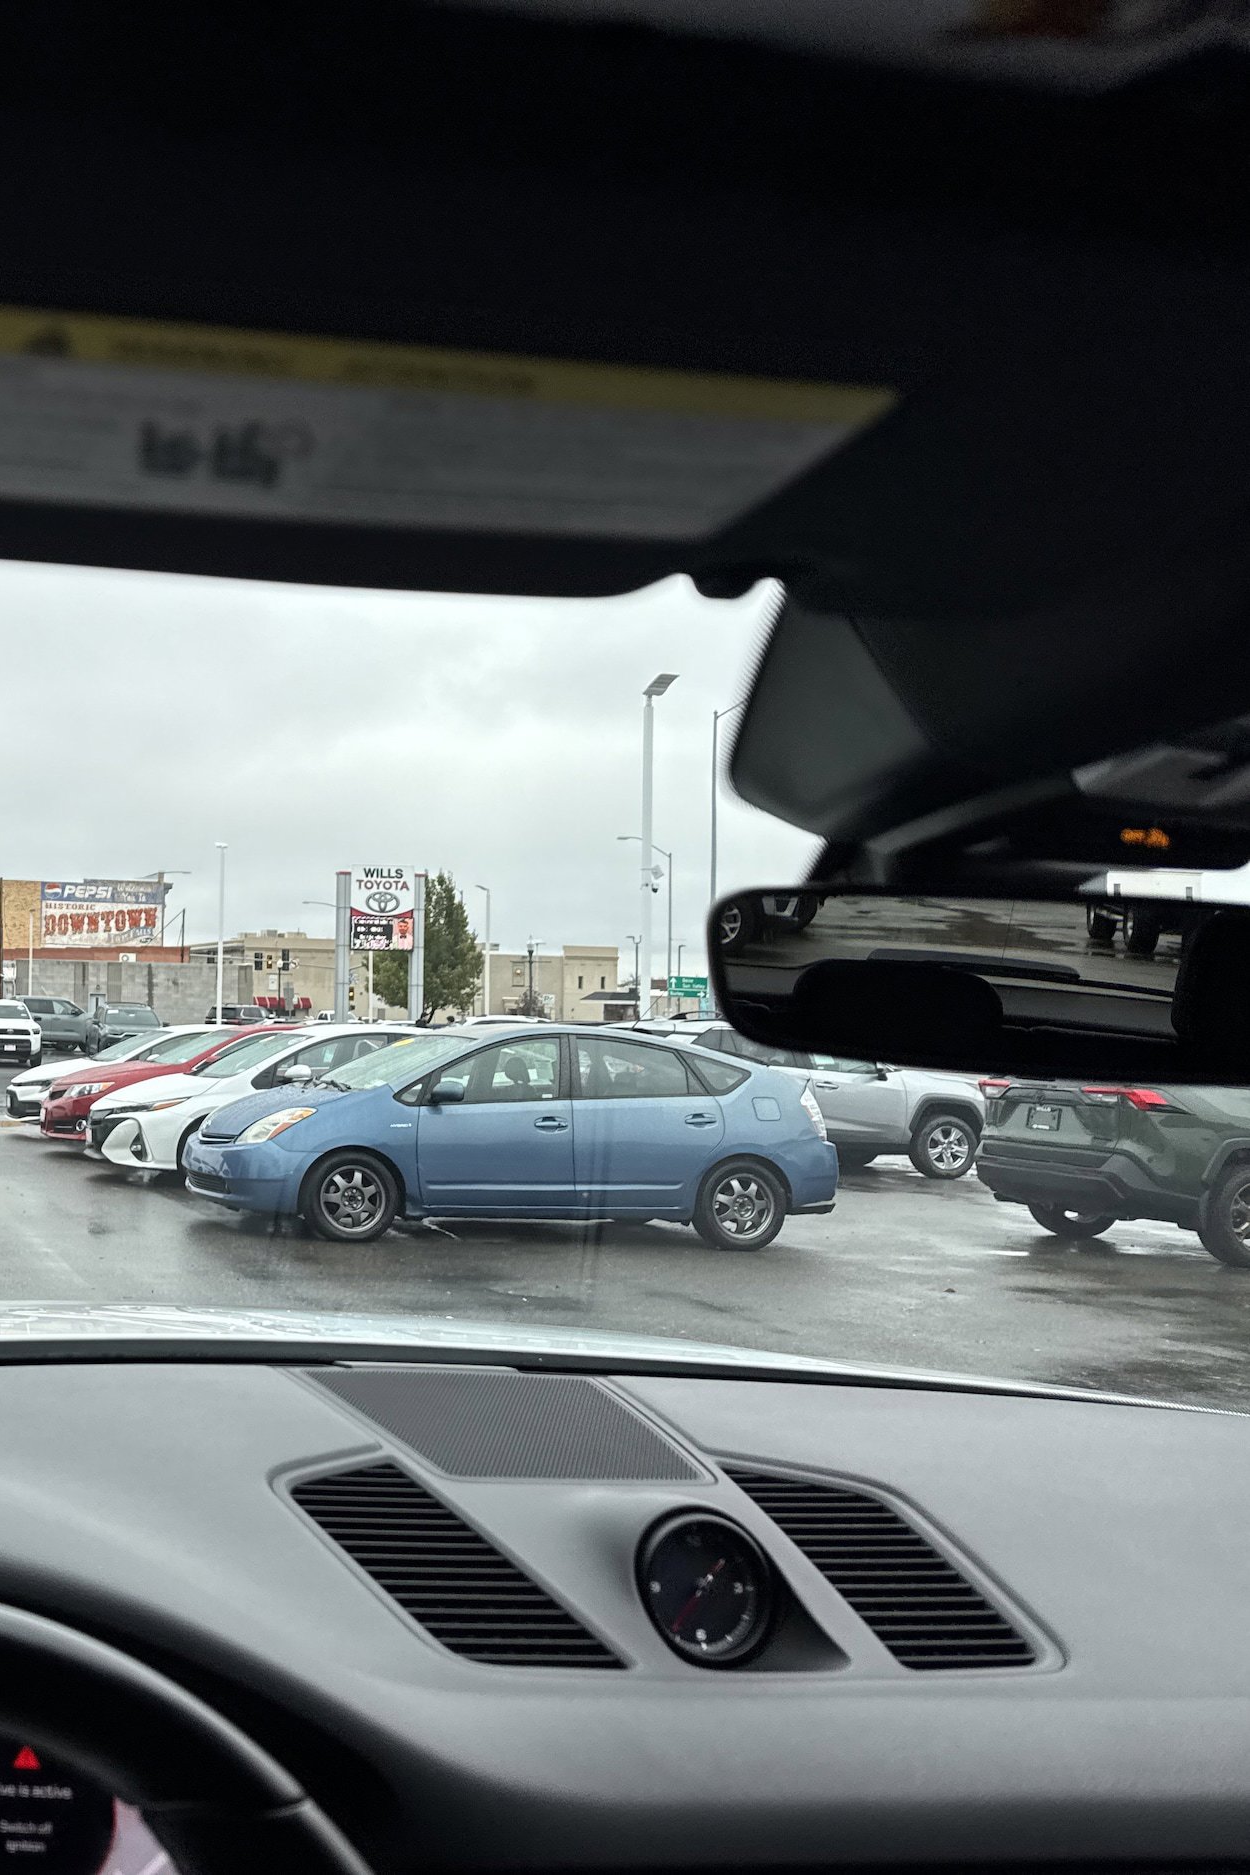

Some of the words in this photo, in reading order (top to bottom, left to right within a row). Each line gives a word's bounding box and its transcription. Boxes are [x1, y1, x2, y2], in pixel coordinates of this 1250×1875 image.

[363, 867, 404, 879] WILLS
[63, 884, 113, 899] PEPSI
[356, 879, 410, 891] TOYOTA
[44, 902, 96, 911] HISTORIC
[44, 907, 157, 937] DOWNTOWN
[18, 1782, 30, 1798] is
[32, 1784, 73, 1800] active
